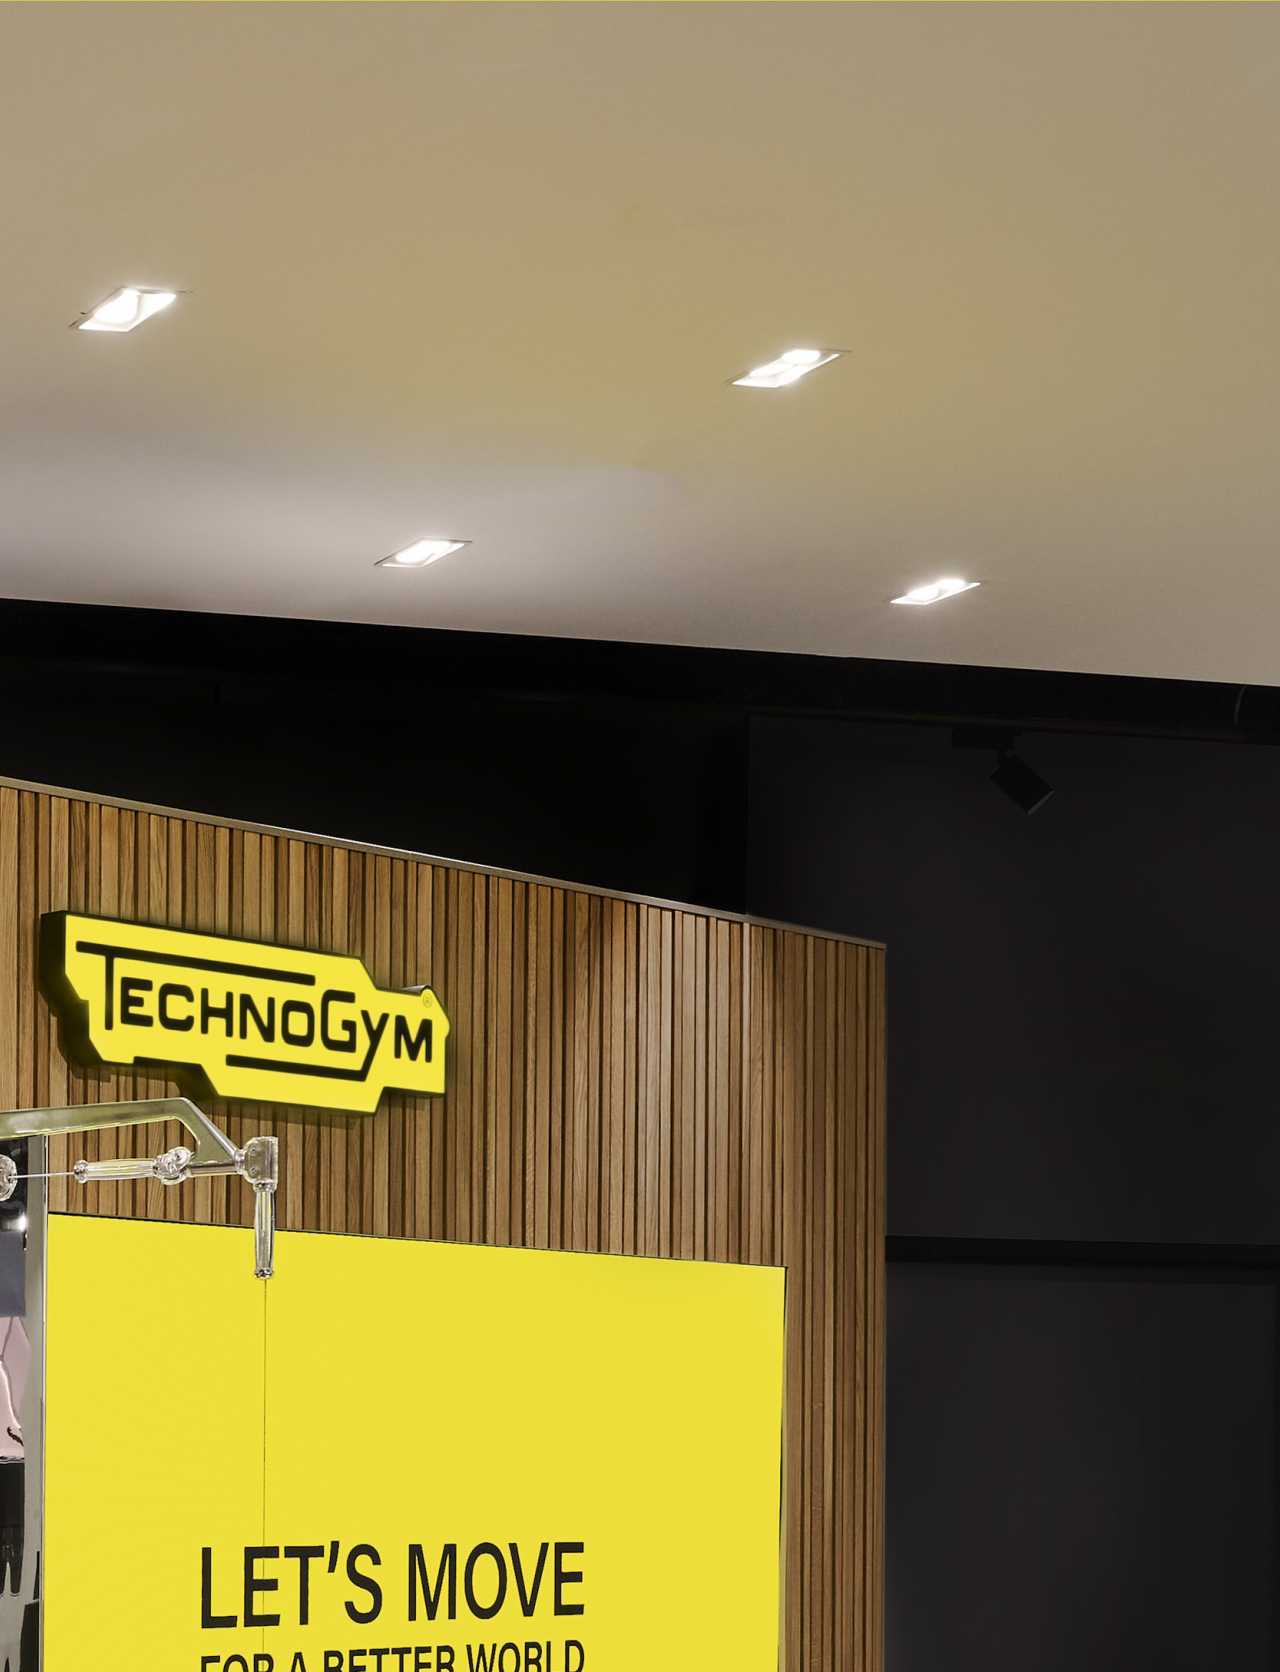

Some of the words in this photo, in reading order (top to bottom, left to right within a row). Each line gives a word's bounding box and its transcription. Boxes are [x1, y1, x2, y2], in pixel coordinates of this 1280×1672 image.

[75, 940, 433, 1082] TECHNOGYM
[201, 1540, 383, 1629] LET'S
[408, 1541, 585, 1622] MOVE
